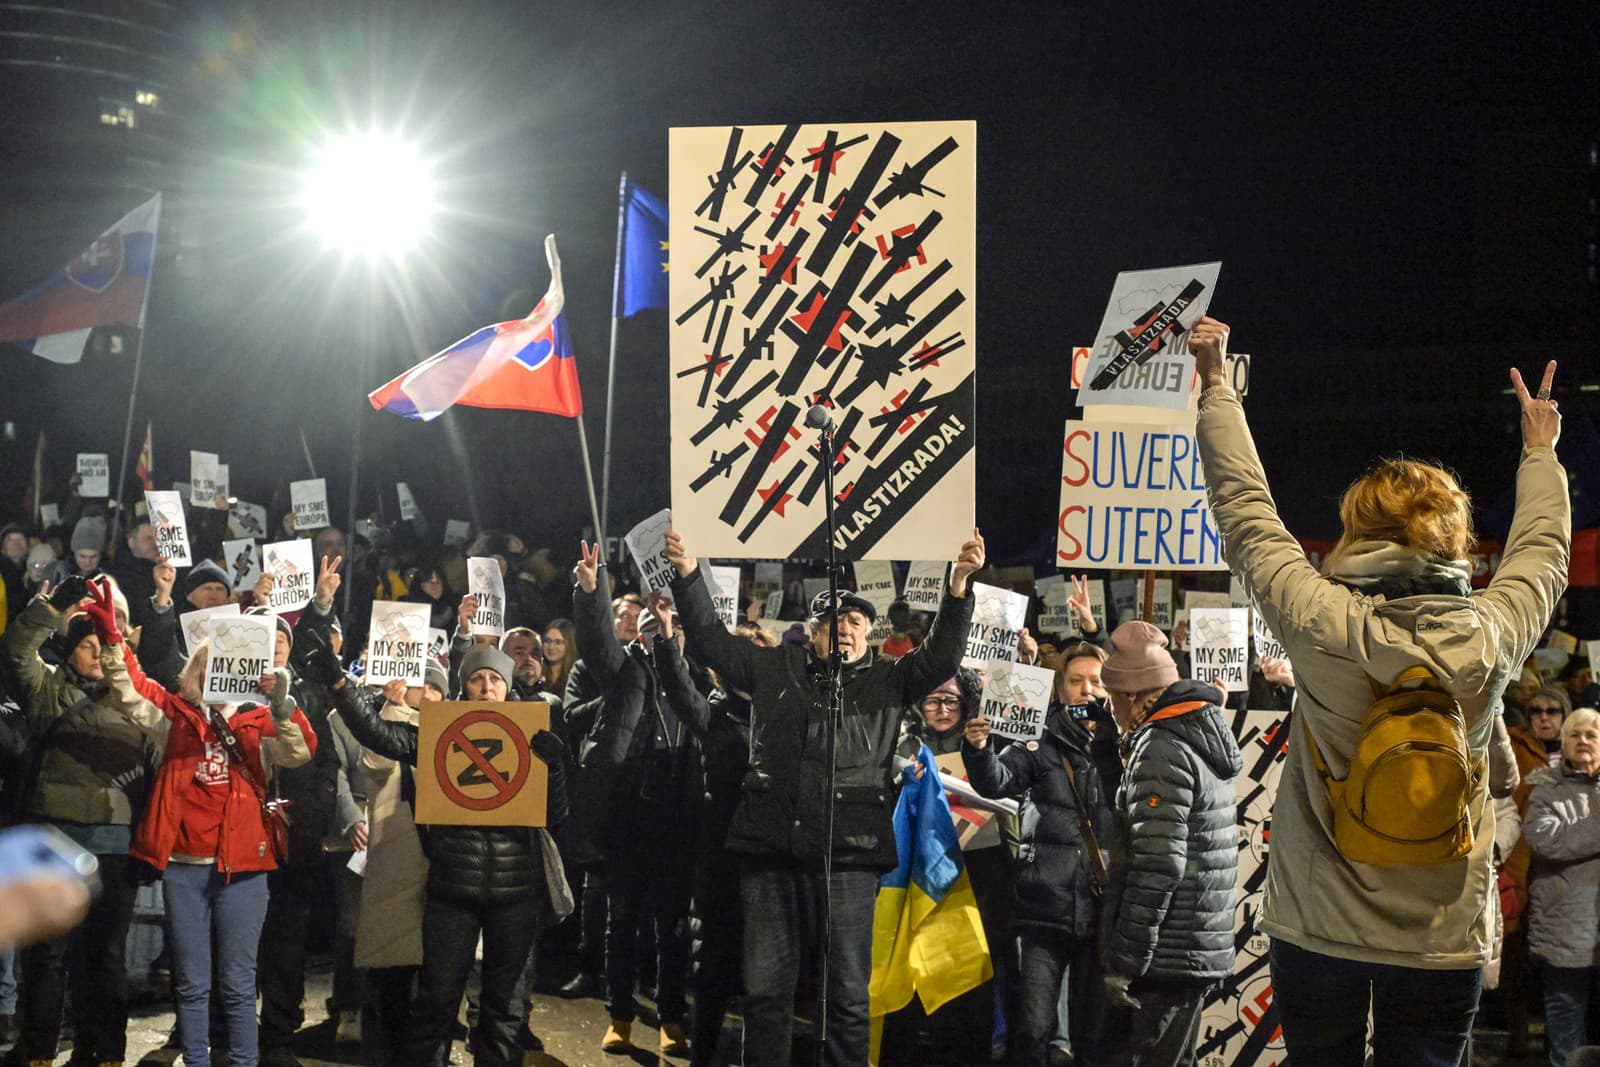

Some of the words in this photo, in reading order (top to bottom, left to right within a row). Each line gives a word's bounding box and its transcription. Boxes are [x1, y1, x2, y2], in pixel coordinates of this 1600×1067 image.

[1106, 298, 1189, 376] VLASTIZRADA
[1062, 430, 1206, 491] SUVERE
[833, 414, 966, 551] VLASTIZRADA!
[642, 555, 660, 576] MY
[287, 572, 311, 588] SME
[909, 577, 922, 589] MY
[922, 577, 942, 590] SME
[269, 588, 310, 607] EURÓPA
[969, 622, 989, 641] MY
[990, 627, 1019, 648] SME
[373, 640, 394, 657] MY
[396, 641, 424, 659] SME
[1195, 647, 1215, 664] MY
[1218, 647, 1245, 664] SME
[211, 656, 235, 674] MY
[238, 657, 270, 676] SME
[371, 658, 421, 677] EURÓPA
[1196, 664, 1243, 684] EURÓPA
[209, 675, 260, 693] EURÓP
[983, 698, 1009, 718] MY
[1010, 704, 1042, 724] SME
